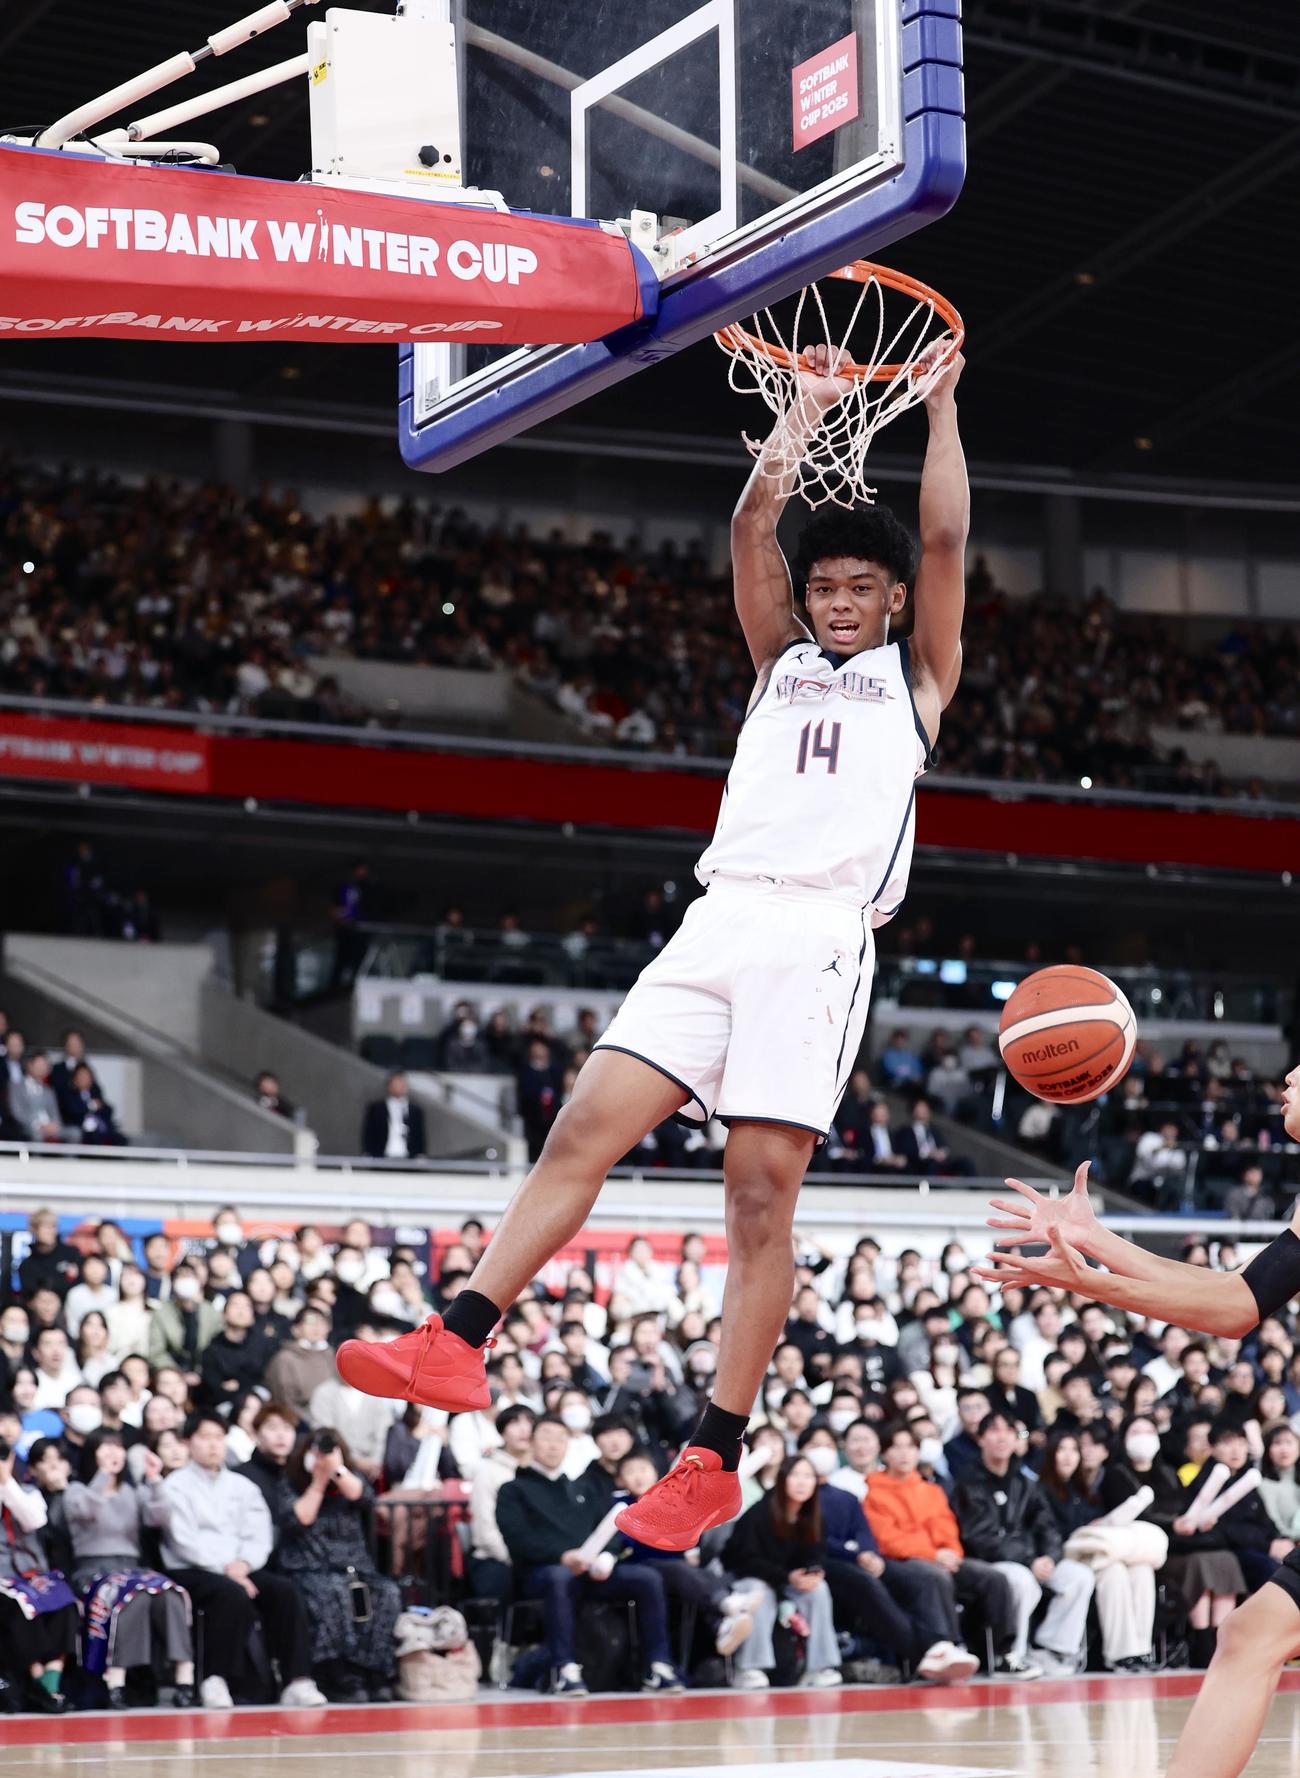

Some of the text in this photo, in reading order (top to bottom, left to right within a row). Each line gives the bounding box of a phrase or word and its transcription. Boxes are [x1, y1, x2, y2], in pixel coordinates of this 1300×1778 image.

[800, 53, 849, 94] SOFTBANK
[800, 91, 848, 130] CUP 2025
[15, 201, 259, 260] SOFTBANK
[447, 240, 538, 285] CUP
[0, 311, 232, 333] SOFTBANK
[409, 320, 503, 334] CUP
[796, 718, 842, 774] 14
[1022, 1038, 1079, 1064] molten
[1037, 1070, 1092, 1091] SOFTBANK
